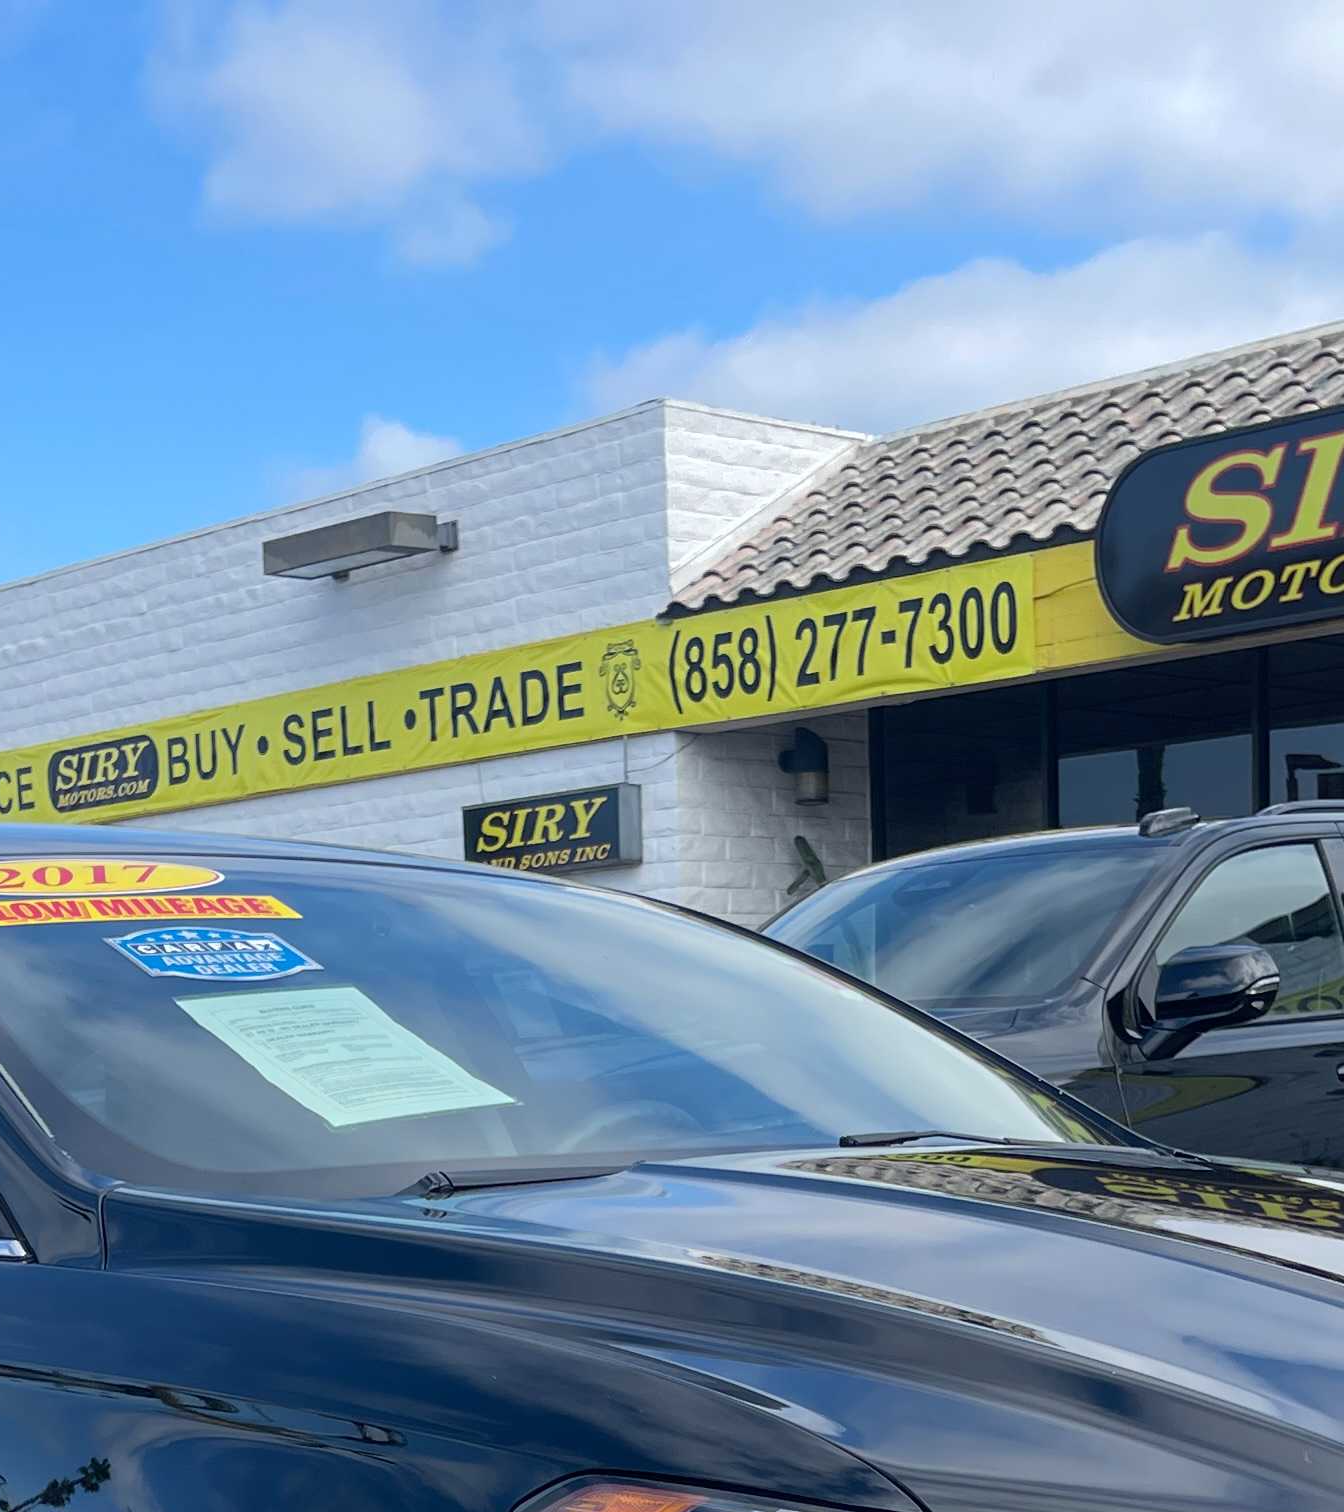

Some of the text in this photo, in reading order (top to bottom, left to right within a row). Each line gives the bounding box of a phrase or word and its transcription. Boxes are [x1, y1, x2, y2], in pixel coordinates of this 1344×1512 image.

[668, 580, 1018, 715] (858) 277-7300
[167, 661, 585, 786] BUY SELL TRADE
[56, 740, 151, 792] SIRY
[56, 779, 151, 809] MOTORS.COM
[476, 796, 609, 853] SIRY
[518, 849, 571, 871] SONS
[573, 843, 612, 863] INC
[90, 897, 276, 918] MILEAGE
[131, 940, 283, 955] CARFAX
[161, 952, 287, 967] ADVANTAGE
[193, 962, 280, 975] DEALER
